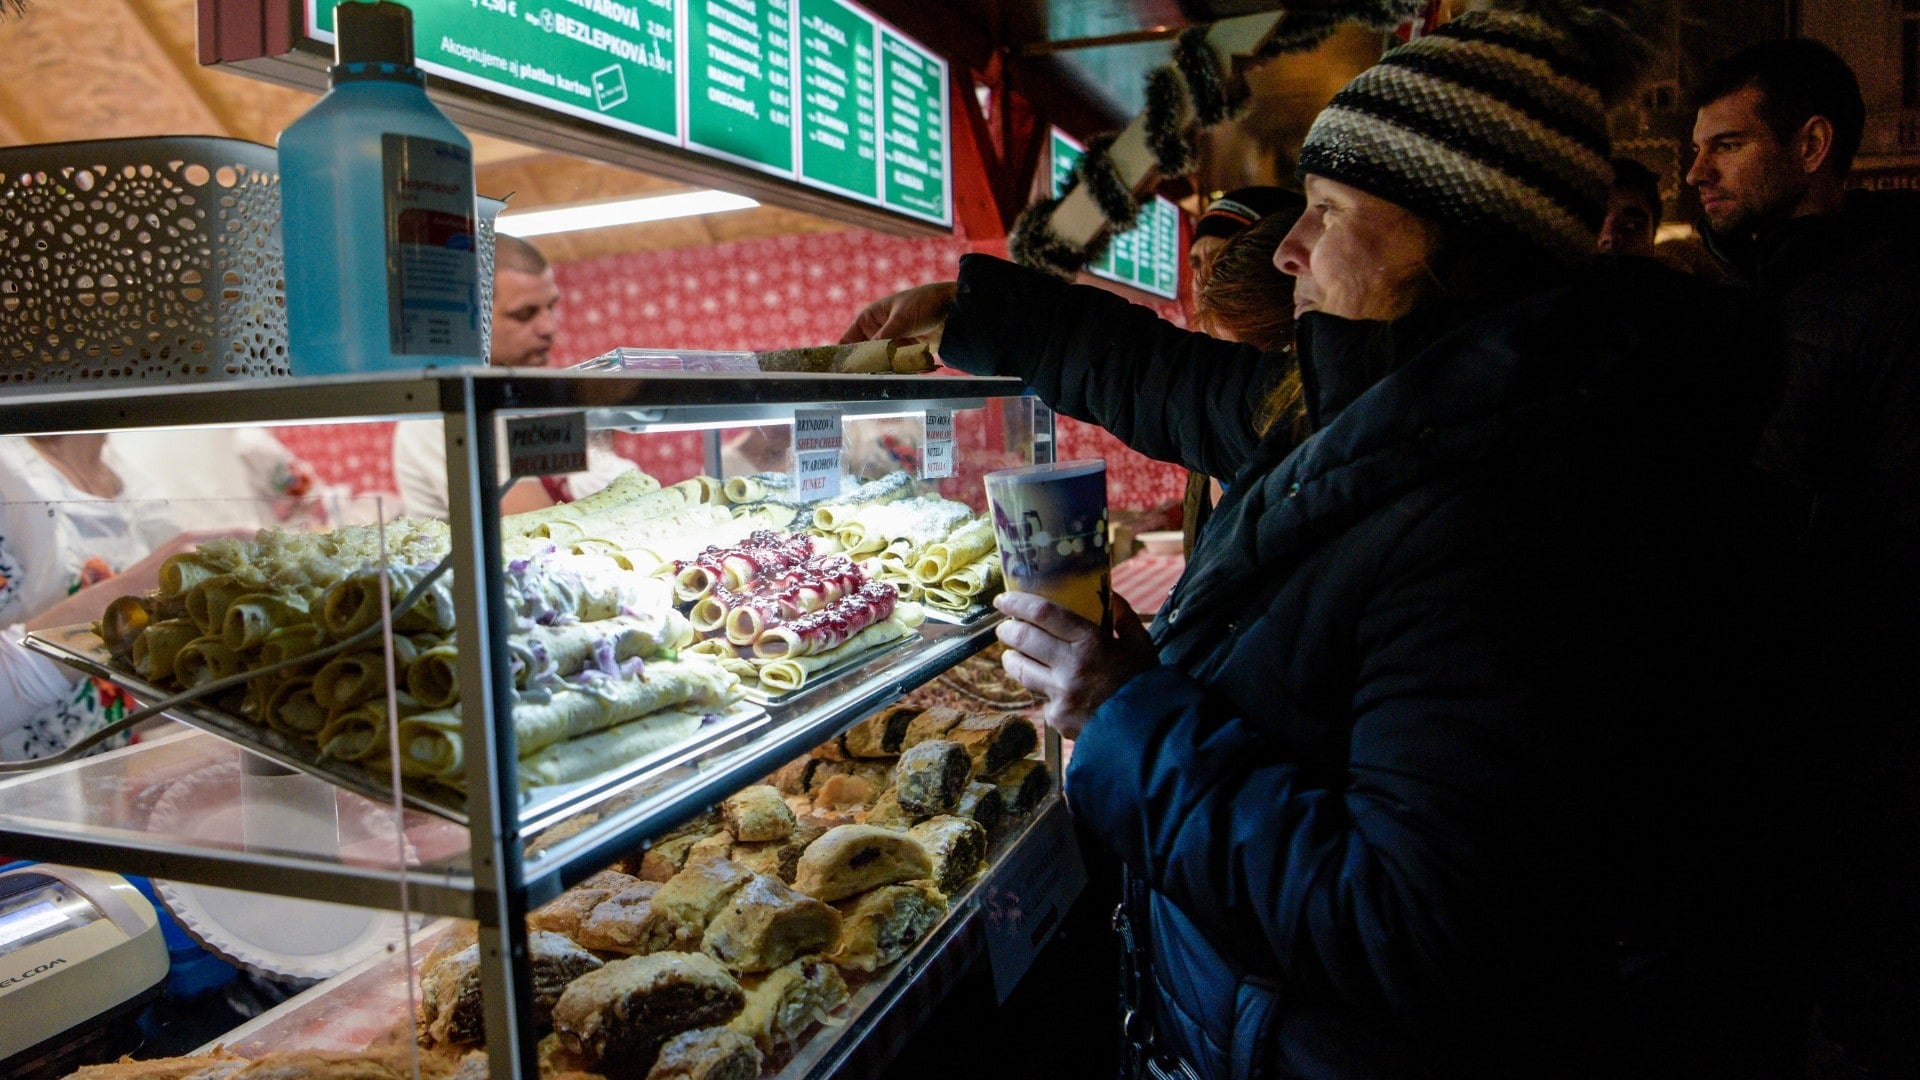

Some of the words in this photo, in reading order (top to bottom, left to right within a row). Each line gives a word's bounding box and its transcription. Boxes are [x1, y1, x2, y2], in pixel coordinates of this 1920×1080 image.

[555, 12, 648, 67] BEZLEPKOVÁ
[440, 36, 508, 70] Akceptujeme
[509, 59, 519, 78] aj
[519, 63, 555, 86] platbu
[557, 73, 592, 98] kartou
[797, 415, 834, 431] BRYNDZOVÁ
[798, 437, 817, 450] SHEEP
[802, 455, 839, 473] TVAROHOVÁ
[802, 477, 826, 491] JUNKET
[0, 957, 67, 988] ELCOM
